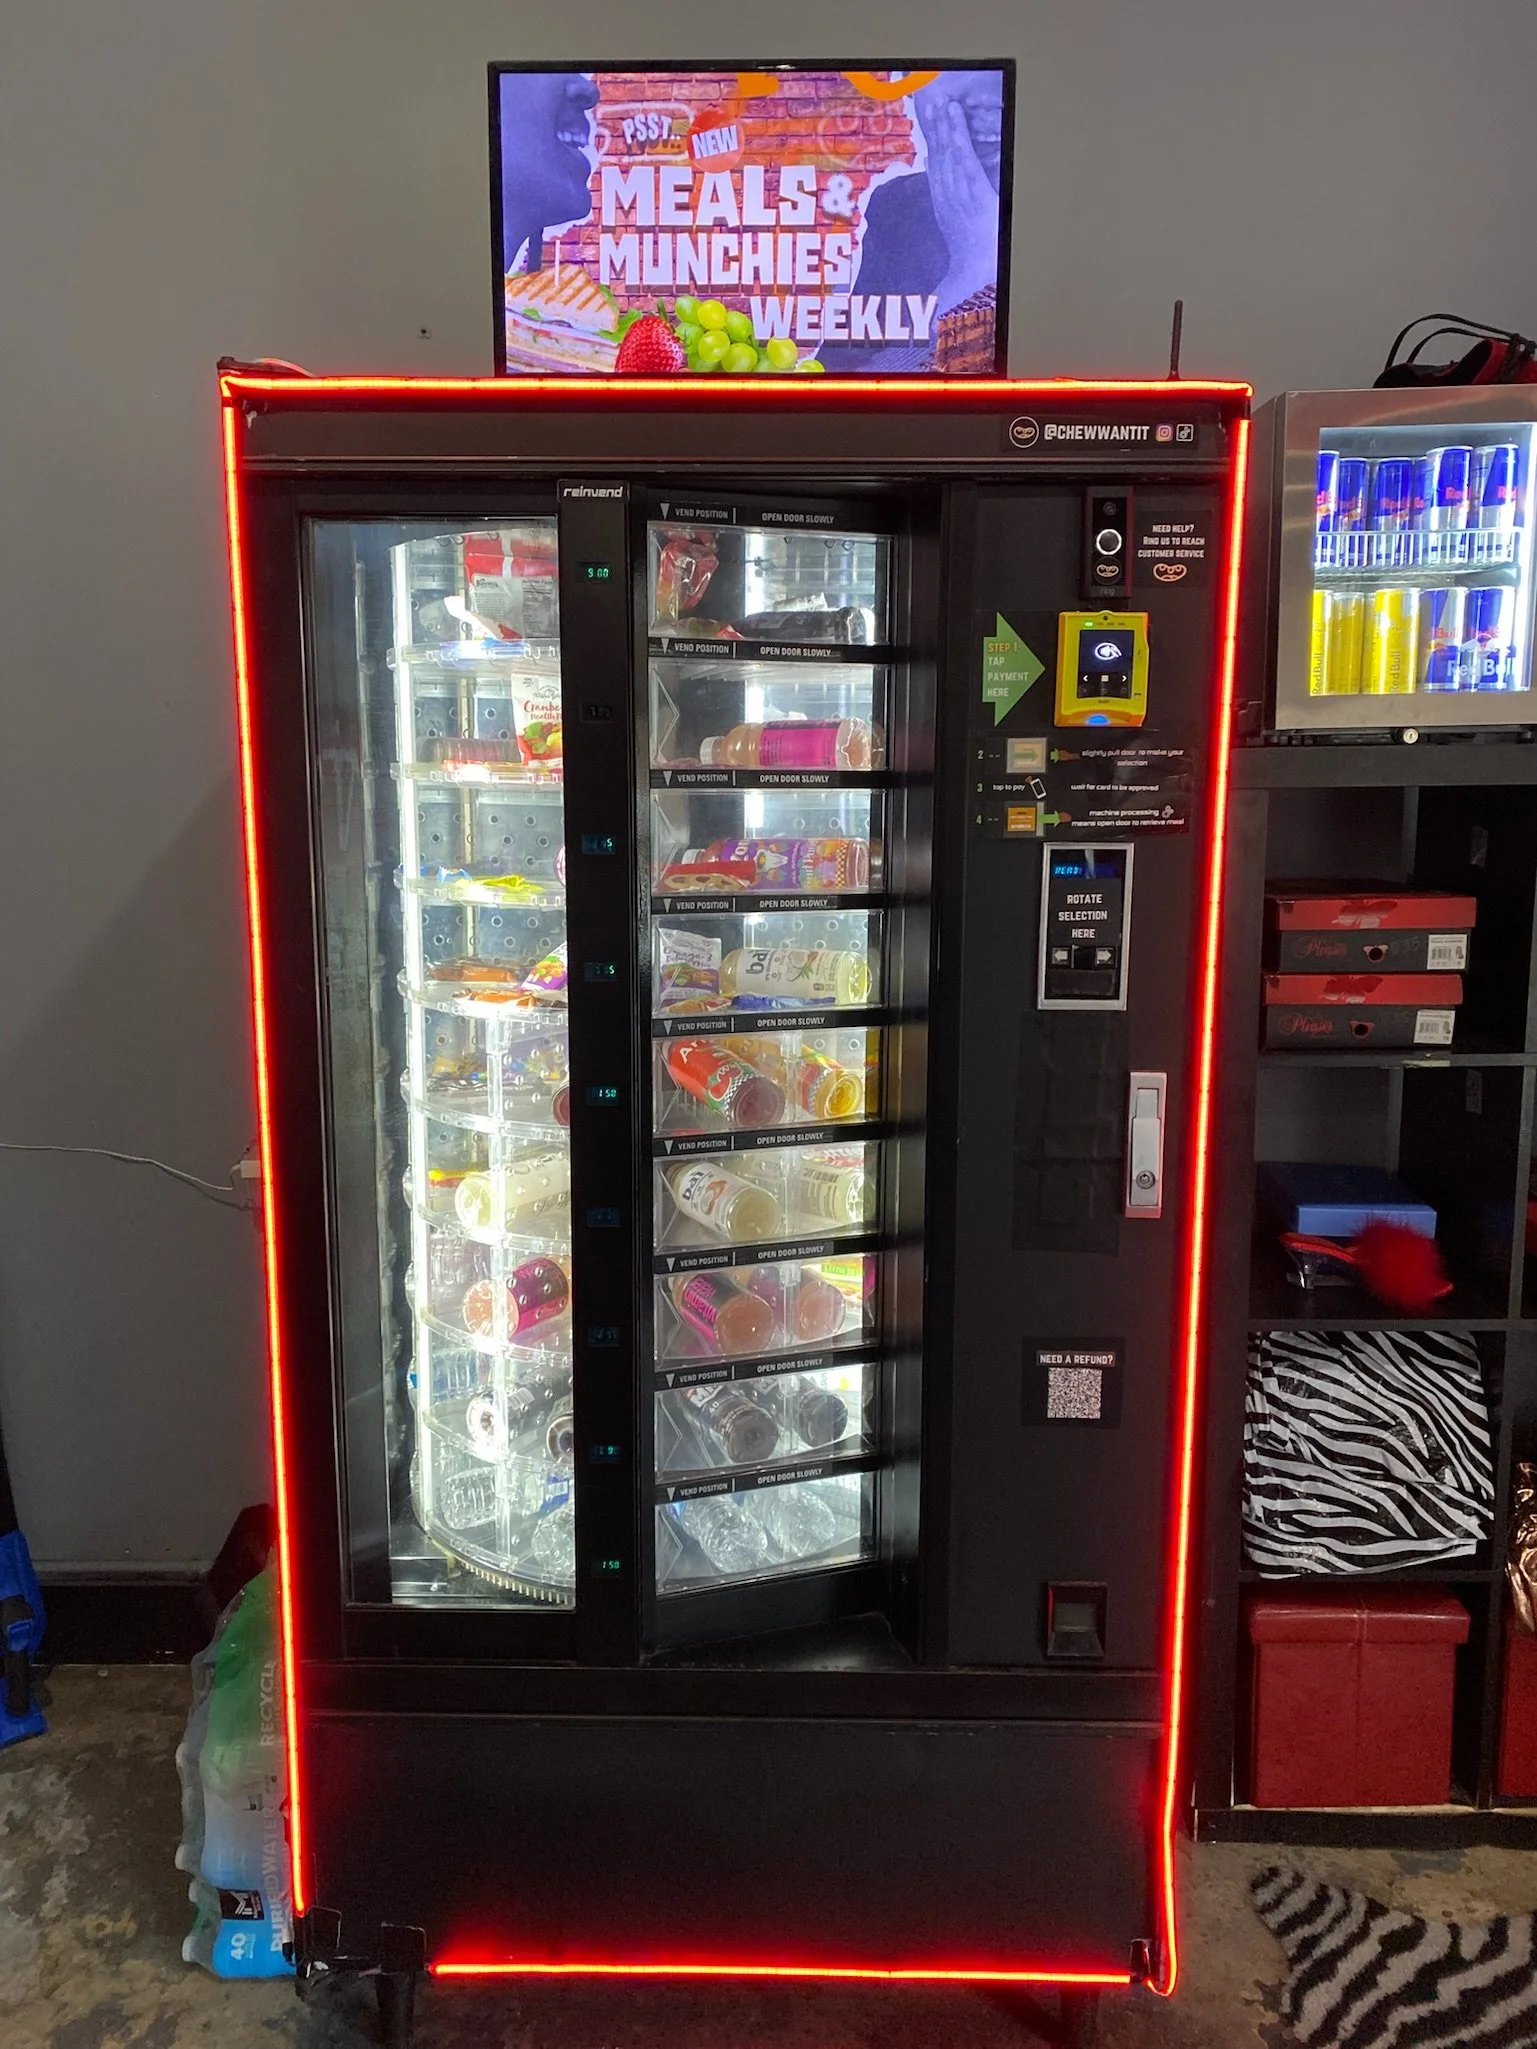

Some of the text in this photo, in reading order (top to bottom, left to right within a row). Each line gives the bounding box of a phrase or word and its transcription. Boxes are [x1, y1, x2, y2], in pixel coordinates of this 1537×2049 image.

[691, 124, 739, 159] NEW
[600, 165, 861, 227] MEALS &
[599, 232, 853, 286] MUNCHIES
[750, 295, 937, 341] WEEKLY
[1043, 424, 1150, 441] @CHEWWANTIT
[563, 486, 623, 498] reinvend
[676, 508, 728, 520] VEND POSITION
[762, 512, 834, 524] OPEN DOOR SLOWLY
[1152, 523, 1195, 533] NEED HELP?
[1160, 537, 1171, 545] US
[1172, 537, 1181, 545] TO
[1182, 537, 1205, 546] REACH
[1138, 549, 1205, 558] CUSTOMER SERVICE
[674, 642, 729, 653] VEND POSITION
[760, 646, 831, 657] OPEN DOOR SLOWLY
[988, 642, 1010, 652] STEP
[988, 656, 1005, 666] TAP
[1390, 652, 1400, 671] Bull
[987, 672, 1029, 681] PAYMENT
[987, 688, 1009, 697] HERE
[978, 750, 984, 760] 2
[1107, 749, 1120, 757] pull
[678, 774, 728, 783] VEND POSITION
[760, 775, 829, 783] OPEN DOOR SLOWLY
[977, 783, 983, 792] 3
[1121, 809, 1159, 817] processing
[976, 815, 982, 824] 4
[780, 900, 800, 908] DOOR
[1067, 894, 1102, 904] ROTATE
[676, 901, 729, 910] VEND POSITION
[1058, 911, 1108, 921] SELECTION
[1072, 929, 1096, 938] HERE
[678, 1022, 727, 1031] VEND POSITION
[757, 1017, 824, 1027] OPEN DOOR SLOWLY
[757, 1133, 823, 1145] OPEN DOOR SLOWLY
[678, 1140, 727, 1150] VEND POSITION
[758, 1246, 824, 1259] OPEN DOOR SLOWLY
[699, 1256, 728, 1265] POSITION
[1040, 1354, 1113, 1364] NEED A REFUND?
[757, 1359, 823, 1373] OPEN DOOR SLOWLY
[679, 1371, 727, 1383] VEND POSITION
[758, 1468, 823, 1484] OPEN DOOR SLOWLY
[680, 1483, 728, 1496] VEND POSITION
[260, 1659, 276, 1746] RECYCLE
[262, 1805, 278, 1870] WATER
[230, 1932, 246, 1960] 40
